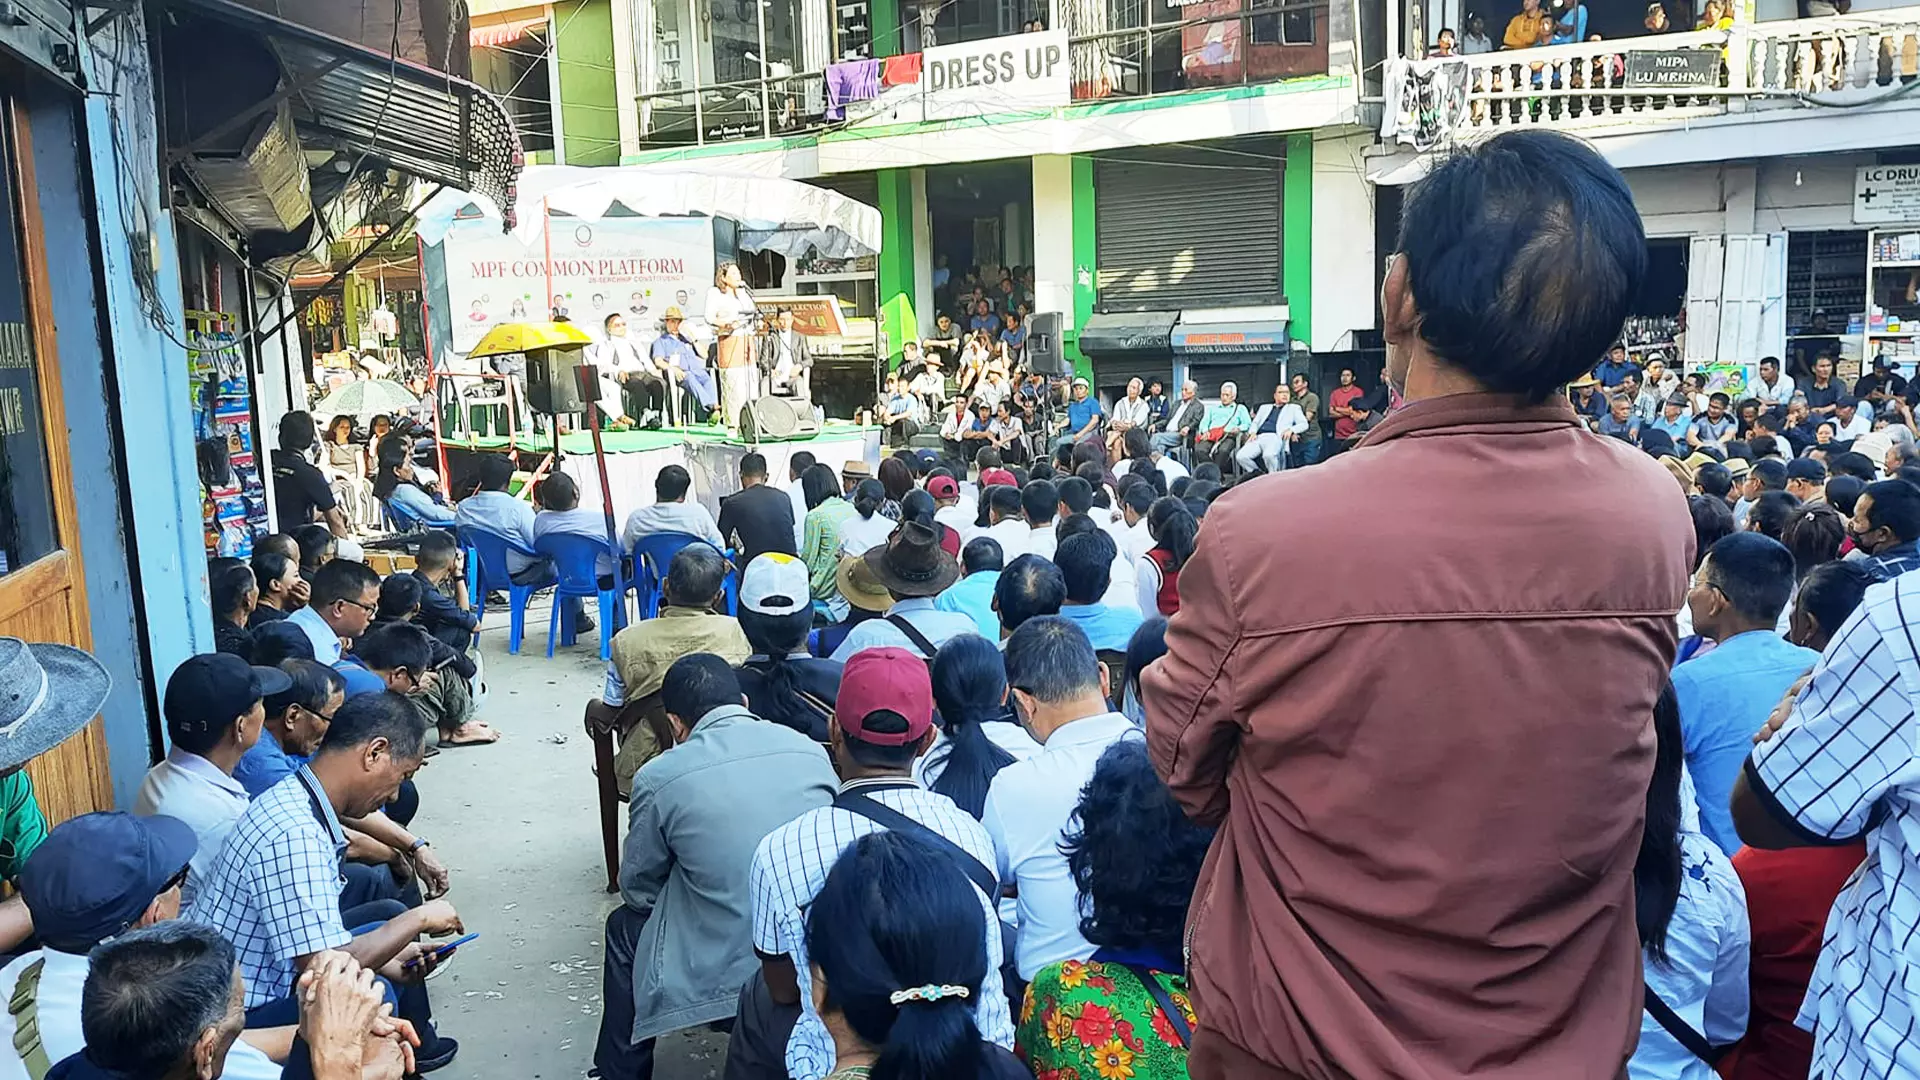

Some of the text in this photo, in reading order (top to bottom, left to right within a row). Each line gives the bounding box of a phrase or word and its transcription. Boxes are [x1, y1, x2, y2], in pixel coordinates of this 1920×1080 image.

[930, 44, 1060, 92] DRESS UP
[1655, 56, 1688, 67] MIPA
[1635, 71, 1706, 83] LU MEHNA
[1865, 167, 1920, 181] LC DRU
[471, 258, 684, 278] MPF COMMON PLATFORM
